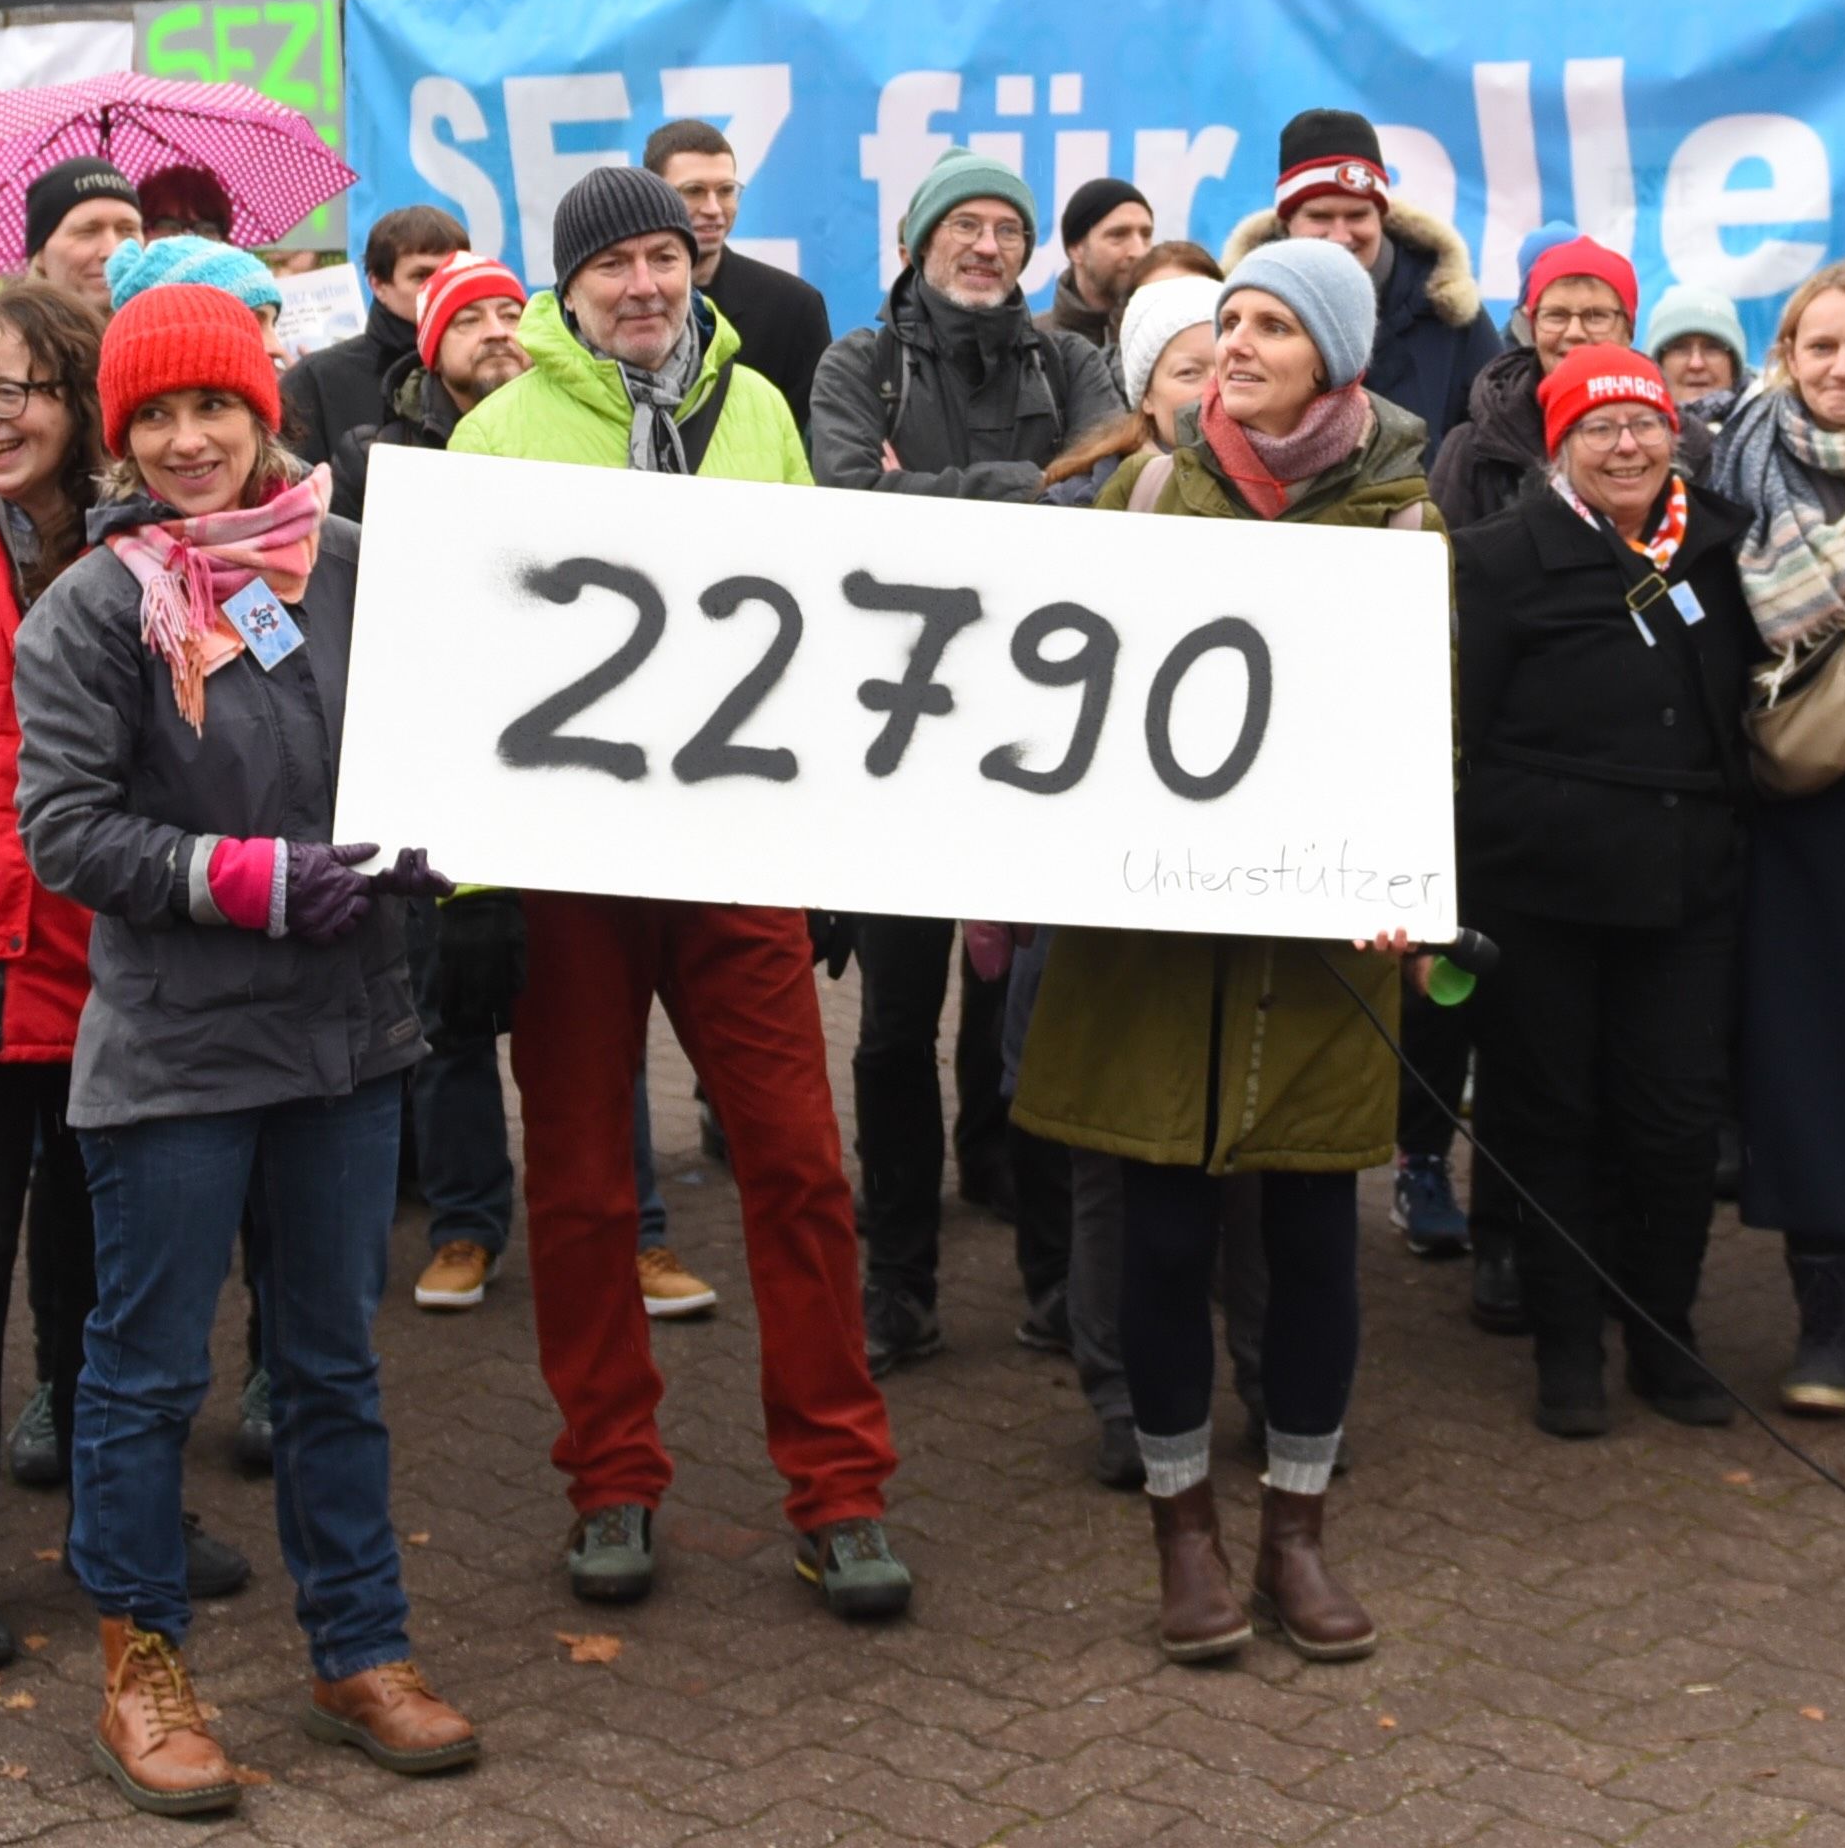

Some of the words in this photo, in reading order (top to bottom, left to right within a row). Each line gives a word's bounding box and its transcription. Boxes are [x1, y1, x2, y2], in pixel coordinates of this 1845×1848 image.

[408, 63, 801, 289] SEZ
[859, 69, 1240, 294] für
[496, 556, 1273, 802] 22790
